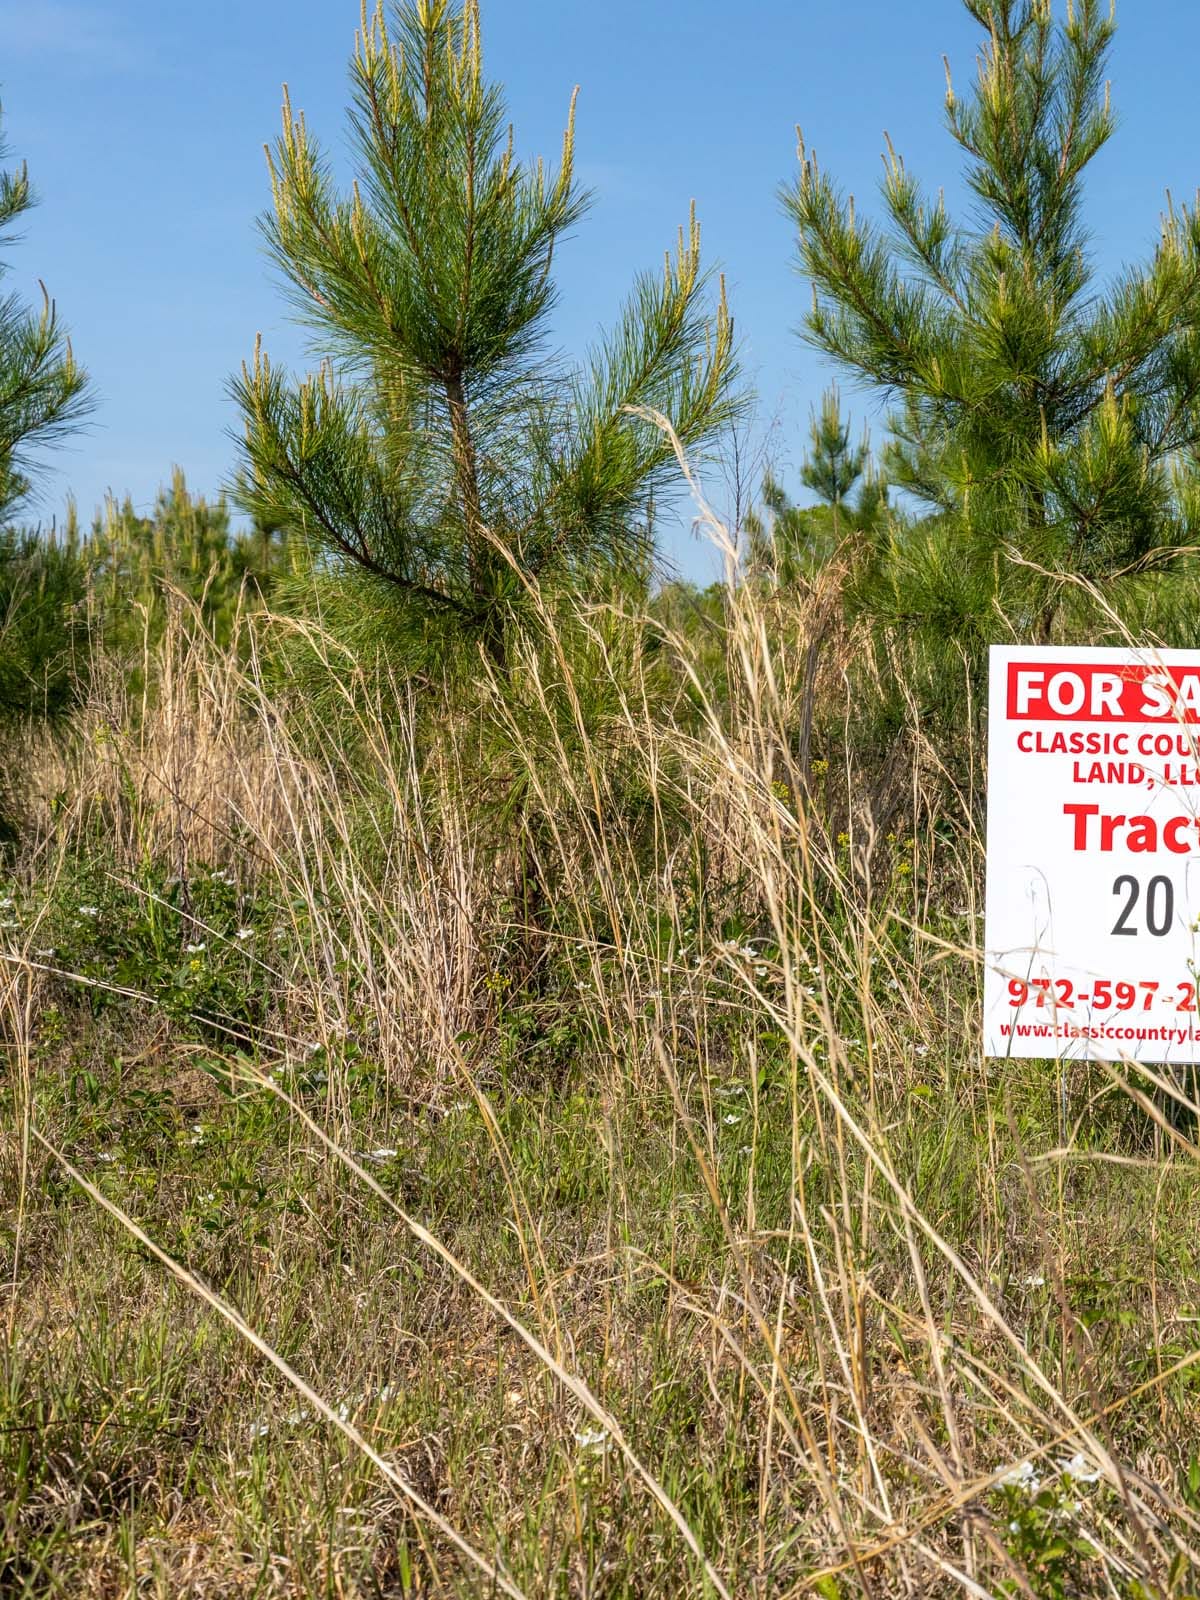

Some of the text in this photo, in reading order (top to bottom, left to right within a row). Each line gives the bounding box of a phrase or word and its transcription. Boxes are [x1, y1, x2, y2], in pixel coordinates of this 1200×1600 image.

[1016, 670, 1125, 716] FOR
[1017, 730, 1129, 755] CLASSIC
[1072, 761, 1155, 791] LAND,
[1110, 873, 1175, 937] 20
